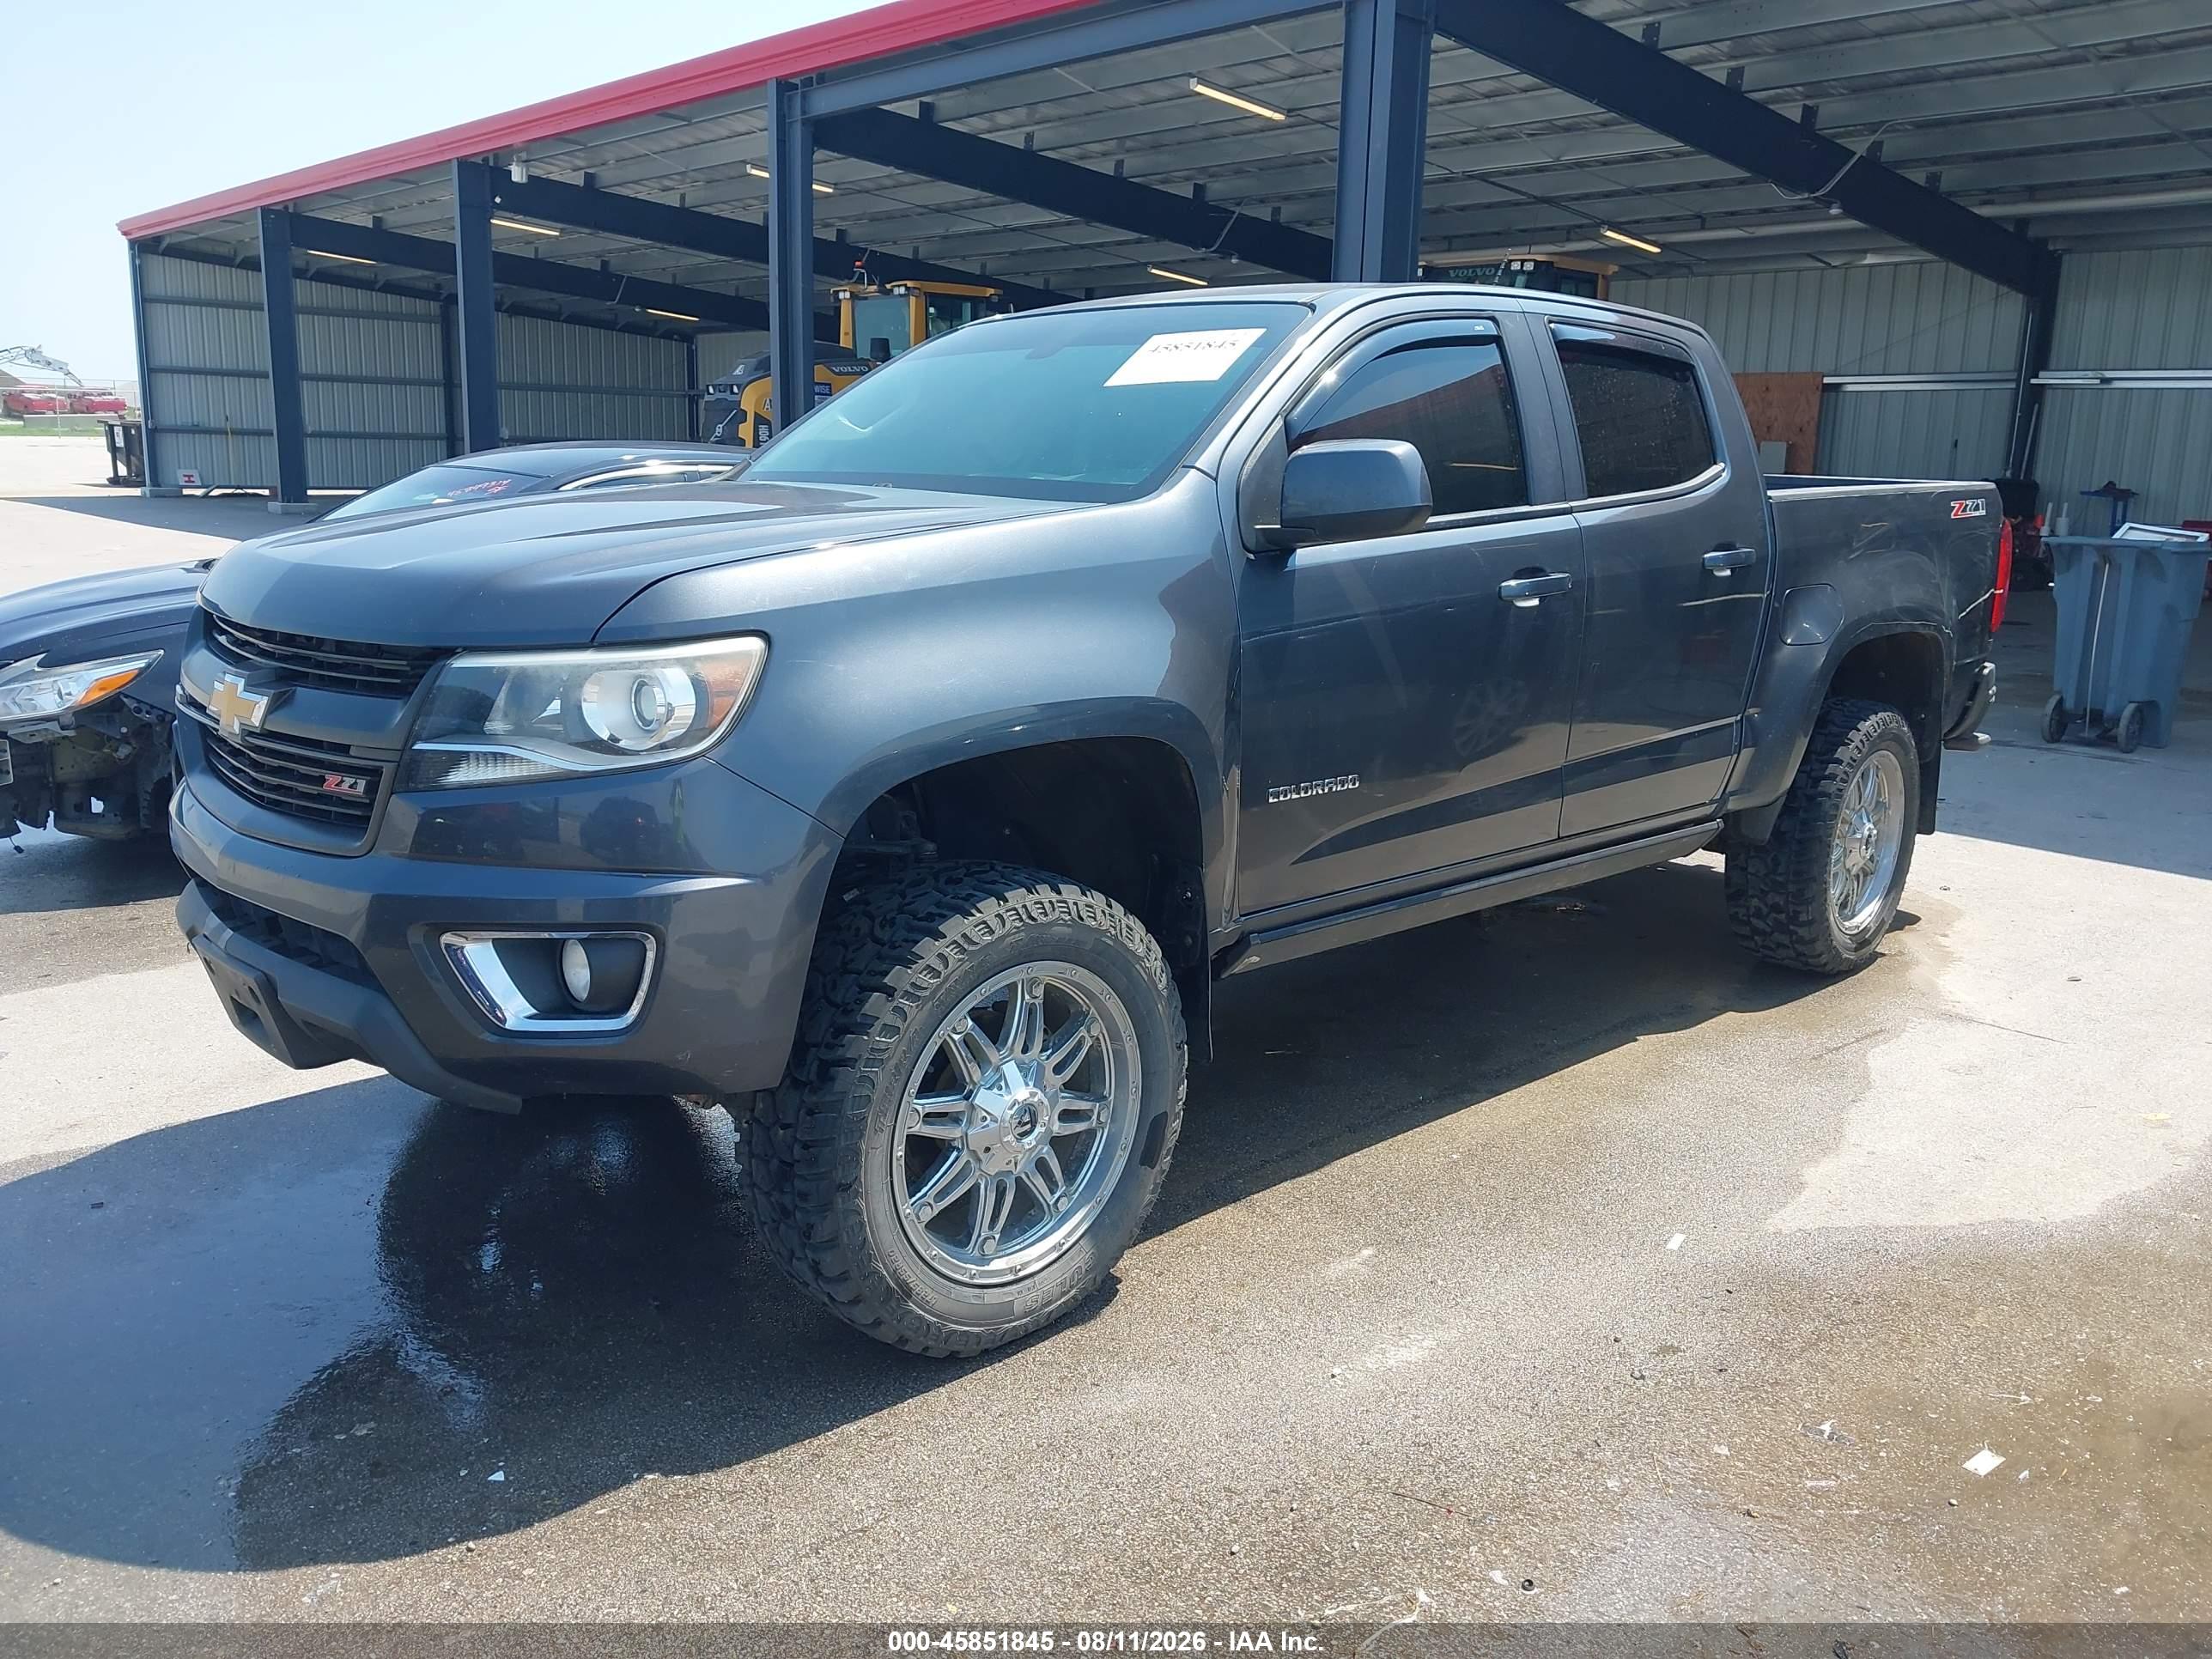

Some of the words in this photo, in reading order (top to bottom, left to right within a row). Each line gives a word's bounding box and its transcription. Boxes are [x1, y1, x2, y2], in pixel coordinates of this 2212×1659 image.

[1449, 267, 1495, 277] VOLVO
[1950, 498, 1986, 519] Z71
[323, 774, 366, 795] Z71
[1268, 774, 1360, 803] COLORADO
